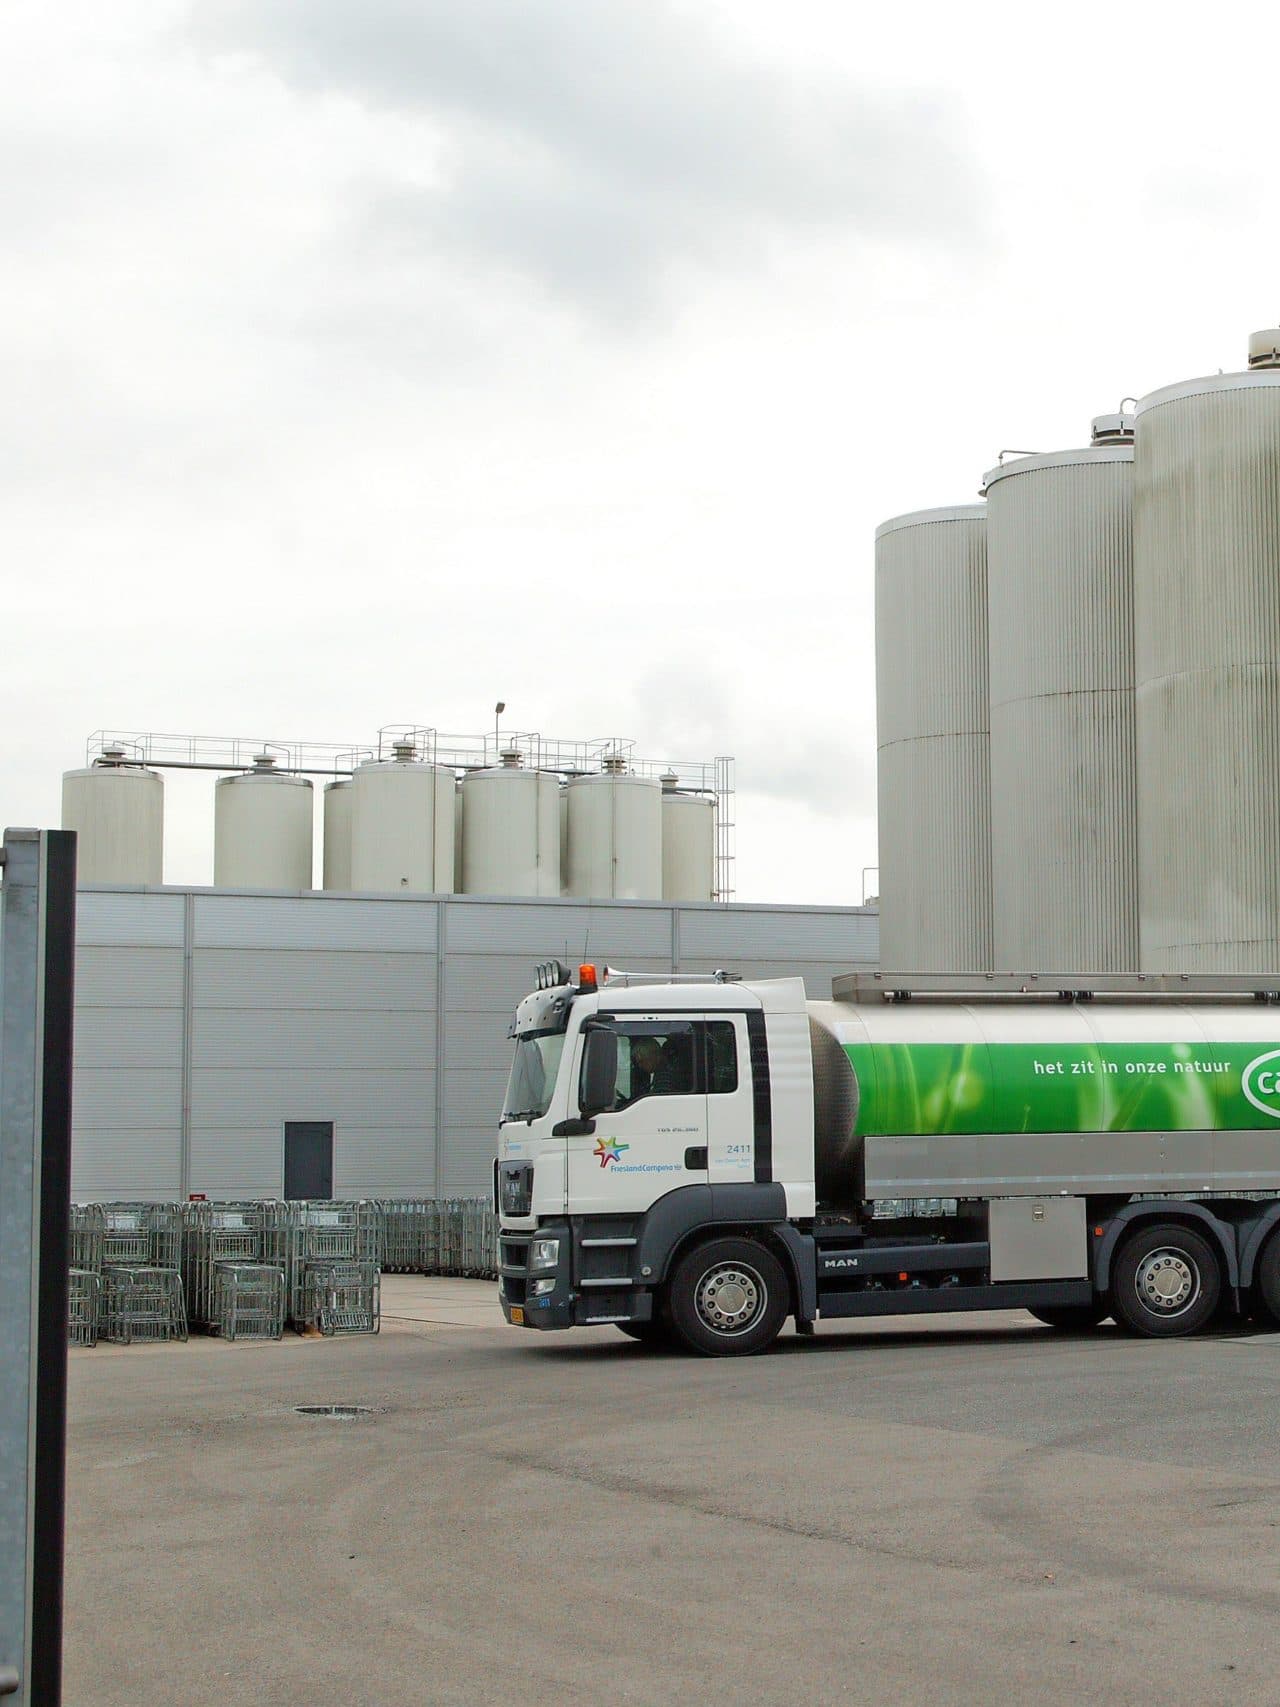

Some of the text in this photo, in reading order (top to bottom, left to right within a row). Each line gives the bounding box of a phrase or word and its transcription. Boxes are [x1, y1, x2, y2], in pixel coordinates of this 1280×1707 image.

[1033, 1060, 1231, 1074] het zit in onze natuur
[727, 1144, 750, 1153] 2411
[824, 1258, 858, 1268] MAN
